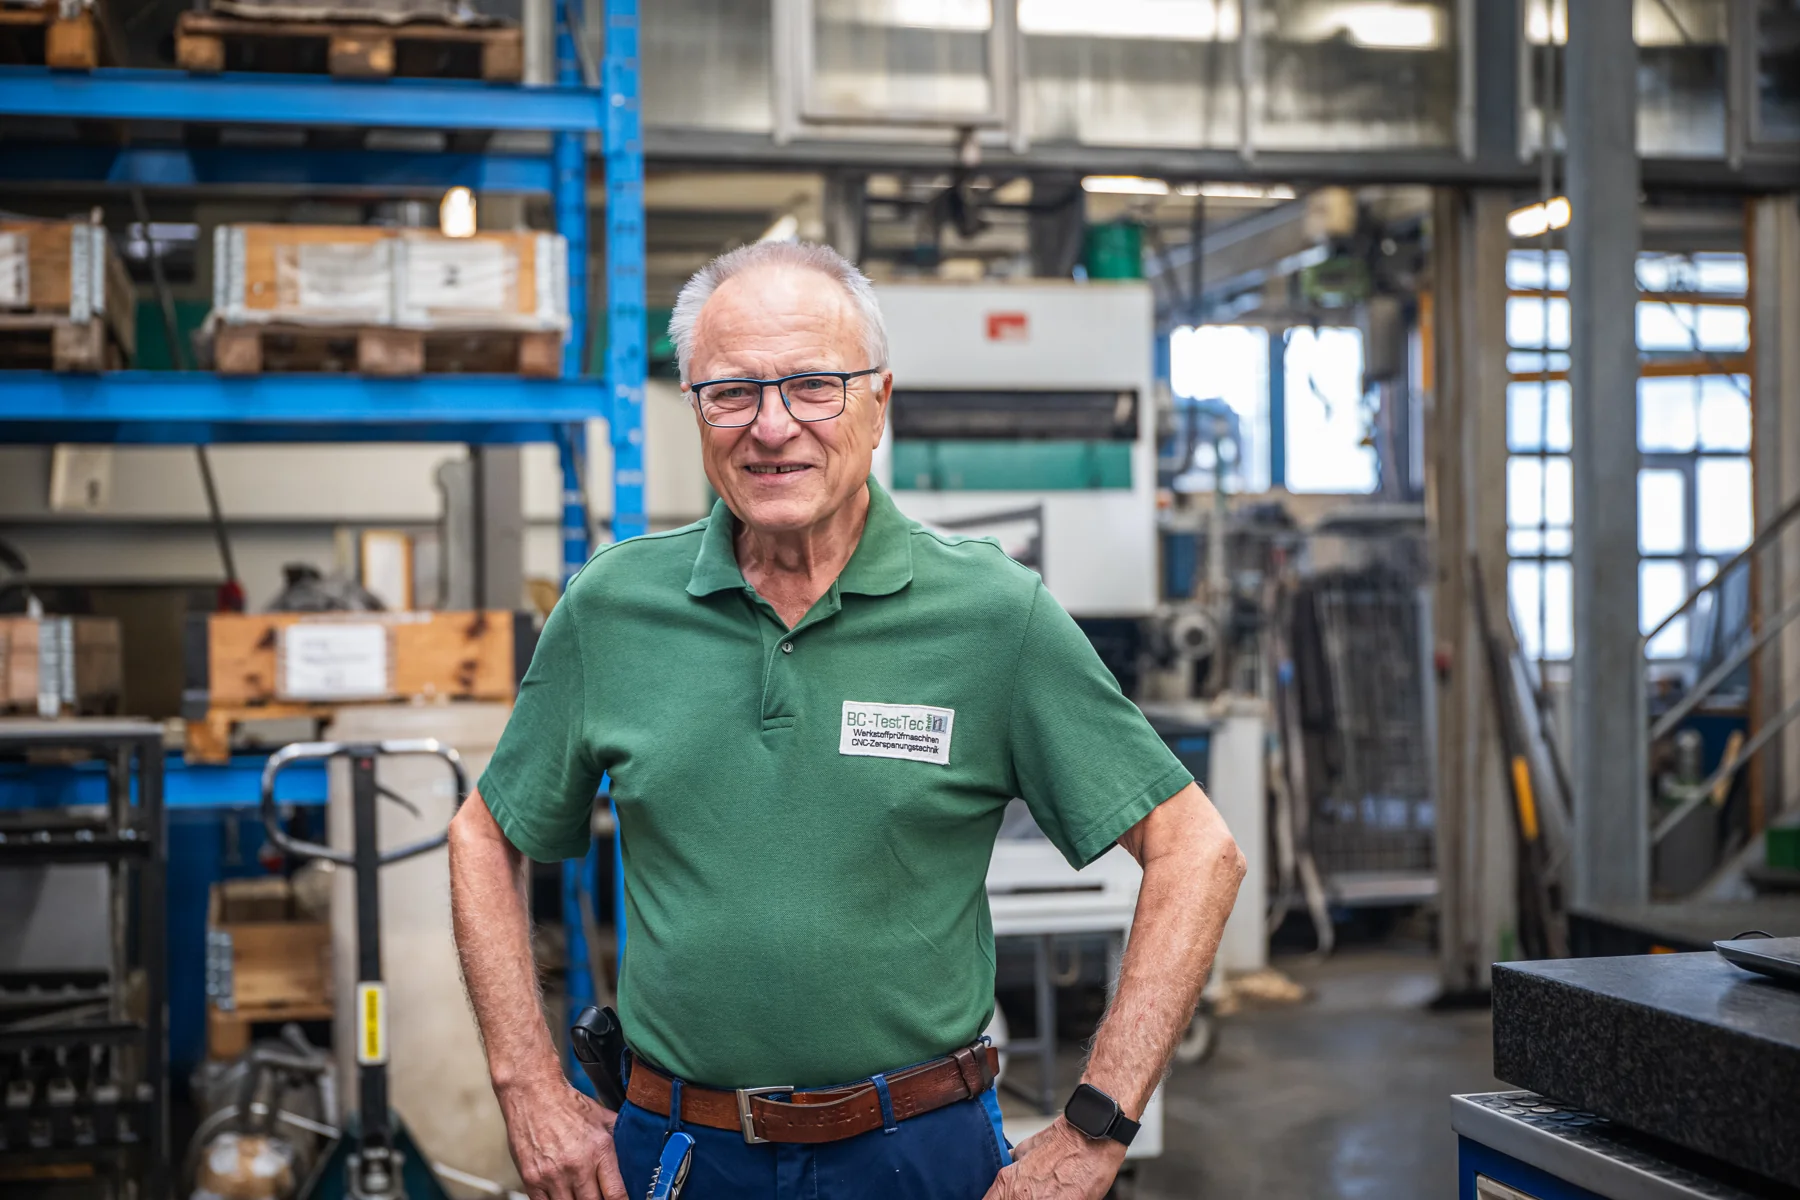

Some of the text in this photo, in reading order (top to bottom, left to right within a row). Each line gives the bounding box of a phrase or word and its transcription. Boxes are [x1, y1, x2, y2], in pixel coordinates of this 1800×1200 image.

[847, 711, 924, 731] BC-TestTec
[853, 728, 940, 744] Werkstoffprüfmaschinen
[851, 738, 939, 754] CNC-Zerspanungstechnik
